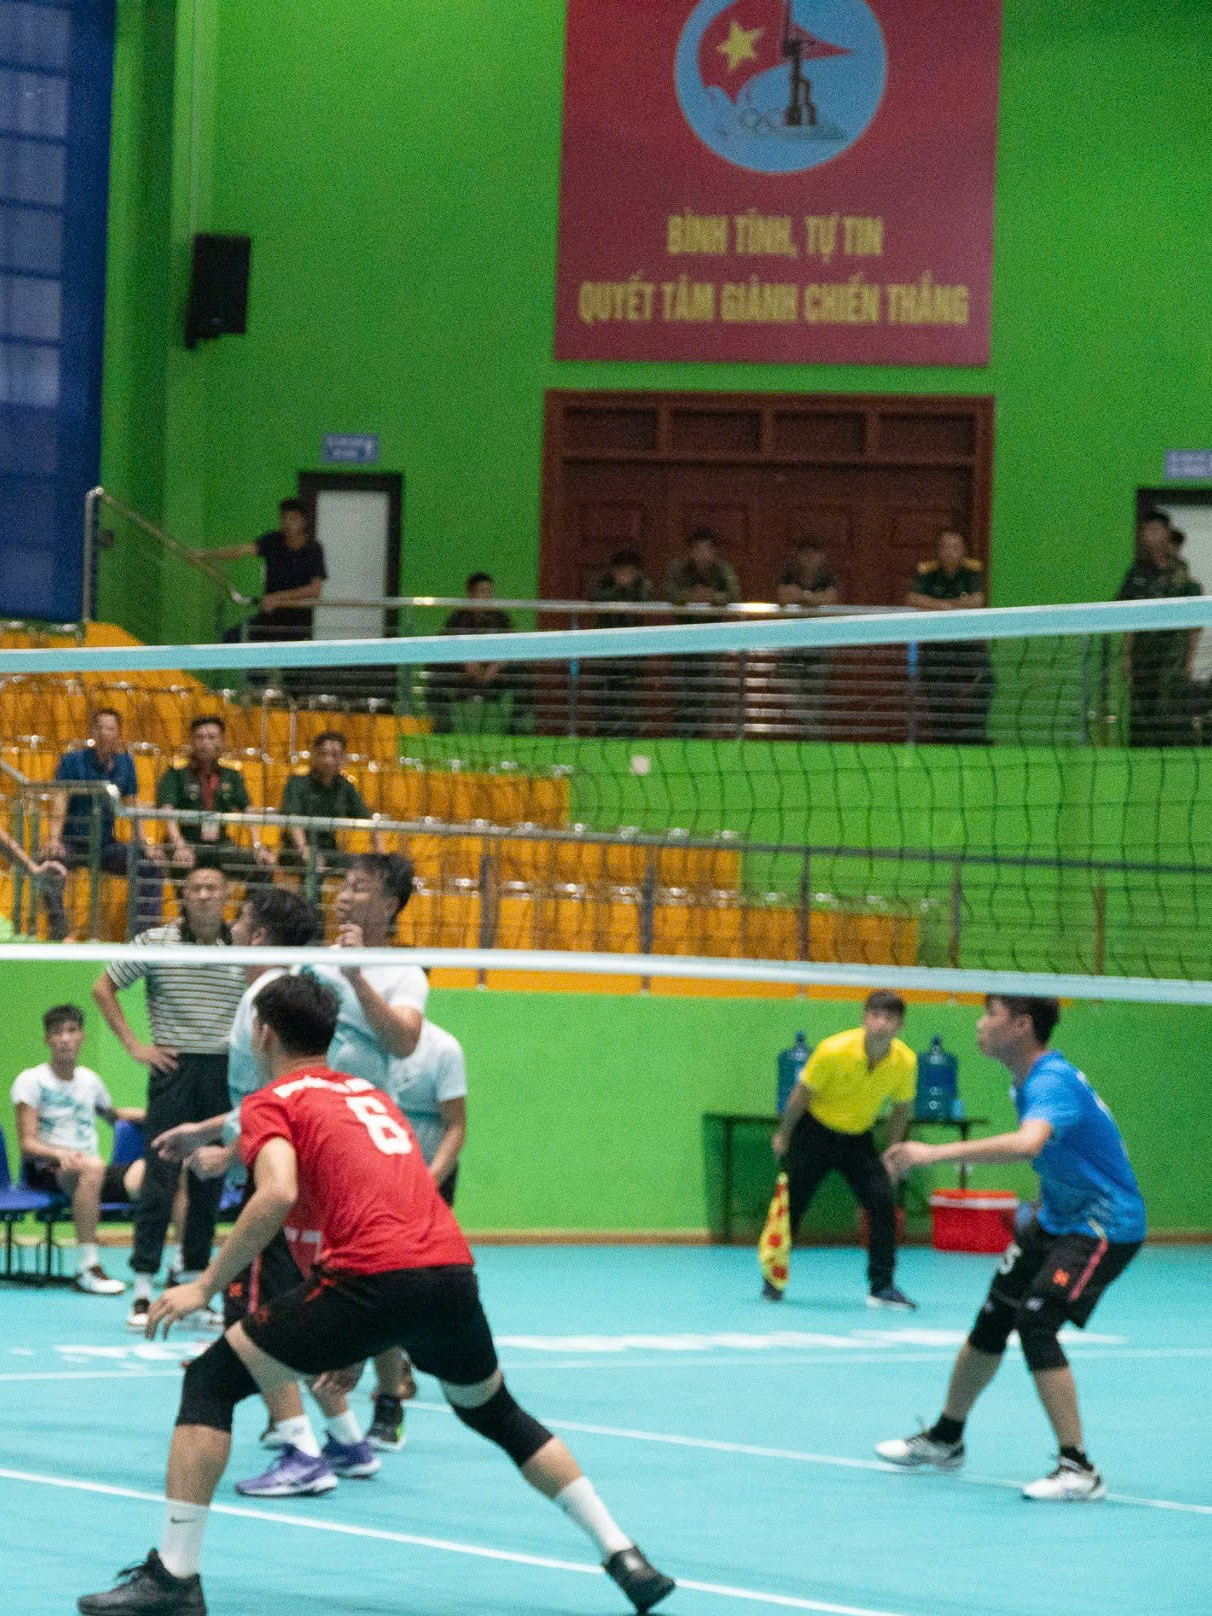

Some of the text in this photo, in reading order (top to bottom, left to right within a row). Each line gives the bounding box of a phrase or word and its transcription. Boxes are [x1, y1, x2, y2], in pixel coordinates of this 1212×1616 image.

[667, 208, 728, 255] BÌNH
[805, 211, 838, 265] TỰ
[843, 215, 883, 255] TIN
[579, 269, 655, 324] QUYẾT
[661, 273, 715, 322] TÂM
[804, 271, 880, 324] CHIẾN
[887, 269, 969, 325] THẮNG
[345, 1095, 413, 1156] 6
